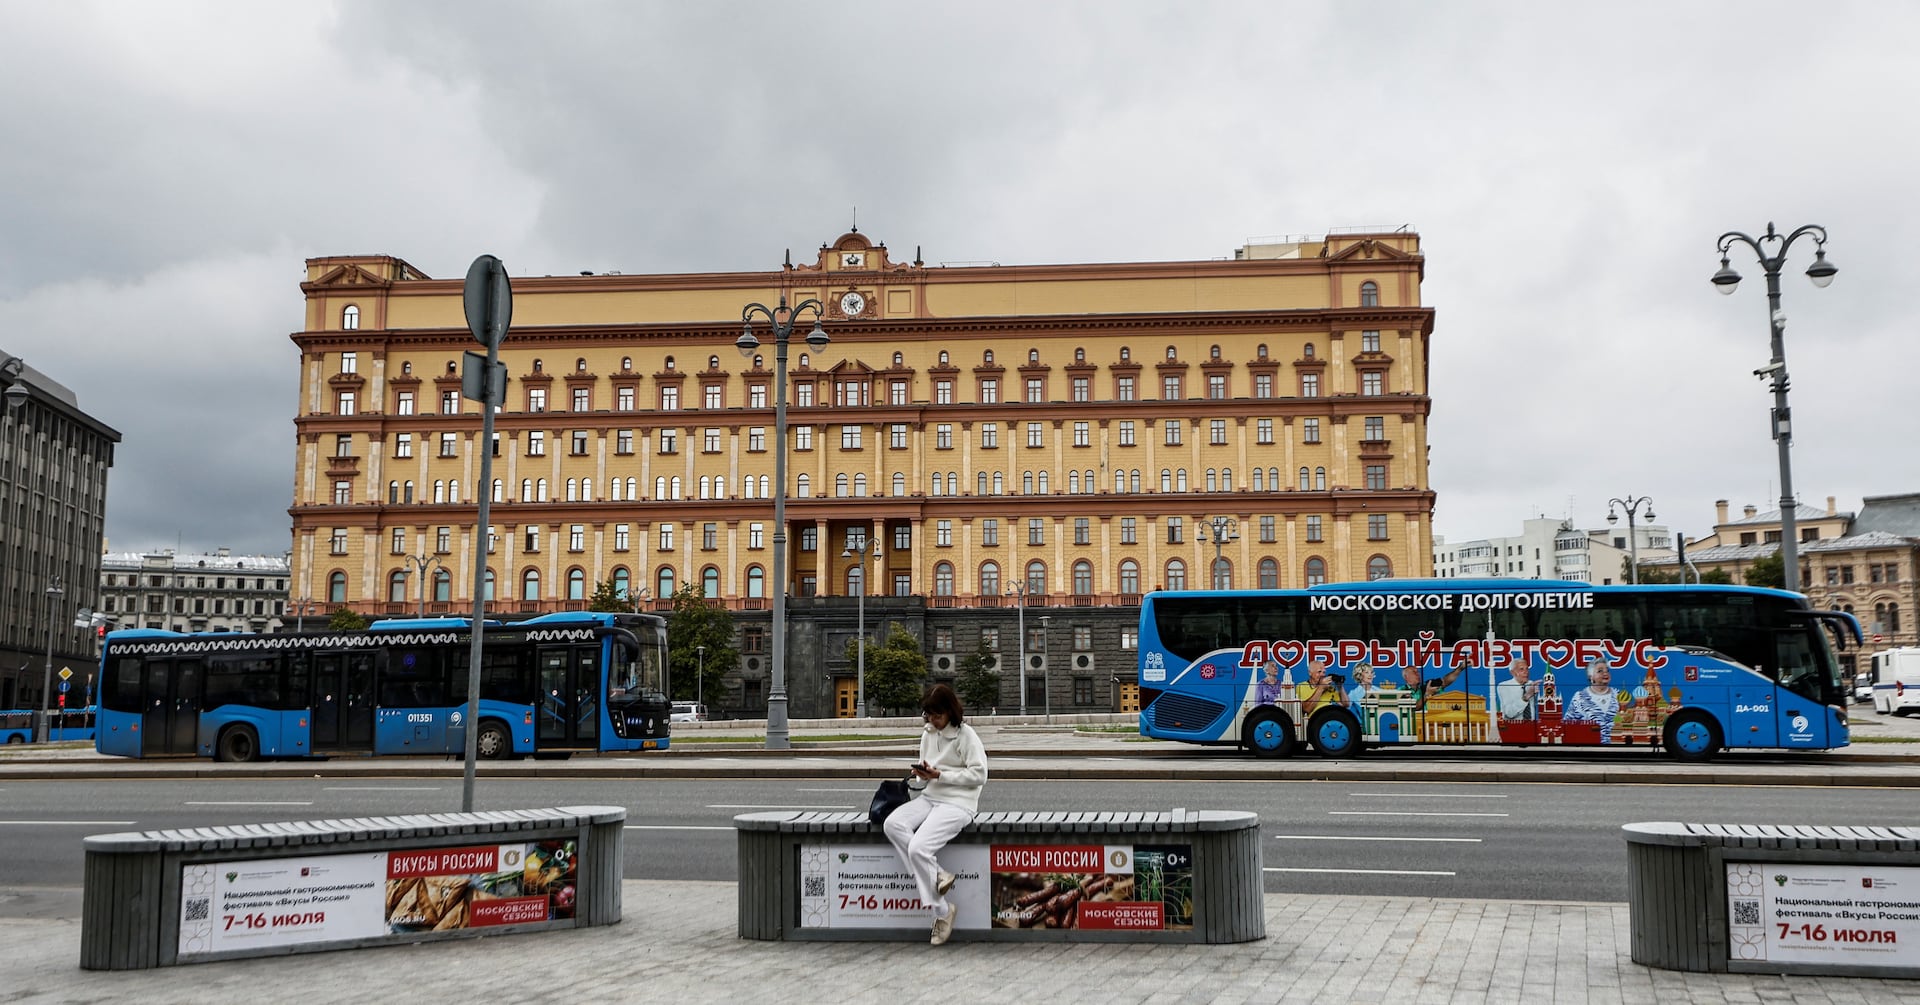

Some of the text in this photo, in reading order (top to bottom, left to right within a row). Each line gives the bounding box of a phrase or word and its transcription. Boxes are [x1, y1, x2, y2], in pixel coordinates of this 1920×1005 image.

[1310, 592, 1594, 612] МОСКОВСКОЕ ДОЛГОЛЕТИЕ
[1736, 704, 1769, 712] ДА-001
[407, 713, 433, 722] 011351
[555, 848, 573, 861] 0+
[996, 850, 1098, 867] ВКУСЫ РОССИИ
[1167, 853, 1187, 866] 0+
[393, 851, 493, 874] ВКУСЫ РОССИИ
[838, 870, 899, 880] Национальный
[223, 886, 291, 900] Национальный
[838, 882, 917, 891] фестиваль «Вкусы
[223, 894, 350, 911] фестиваль «Вкусы России»
[1775, 897, 1852, 907] Национальный
[476, 903, 544, 916] МОСКОВСКИЕ
[502, 911, 544, 921] СЕЗОНЫ
[1084, 910, 1158, 918] МОСКОВСКИЕ
[1775, 908, 1832, 918] фестиваль
[1835, 910, 1876, 920] «Вкусы
[272, 912, 325, 927] июля
[1113, 918, 1158, 926] СЕЗОНЫ
[1833, 929, 1897, 943] июля
